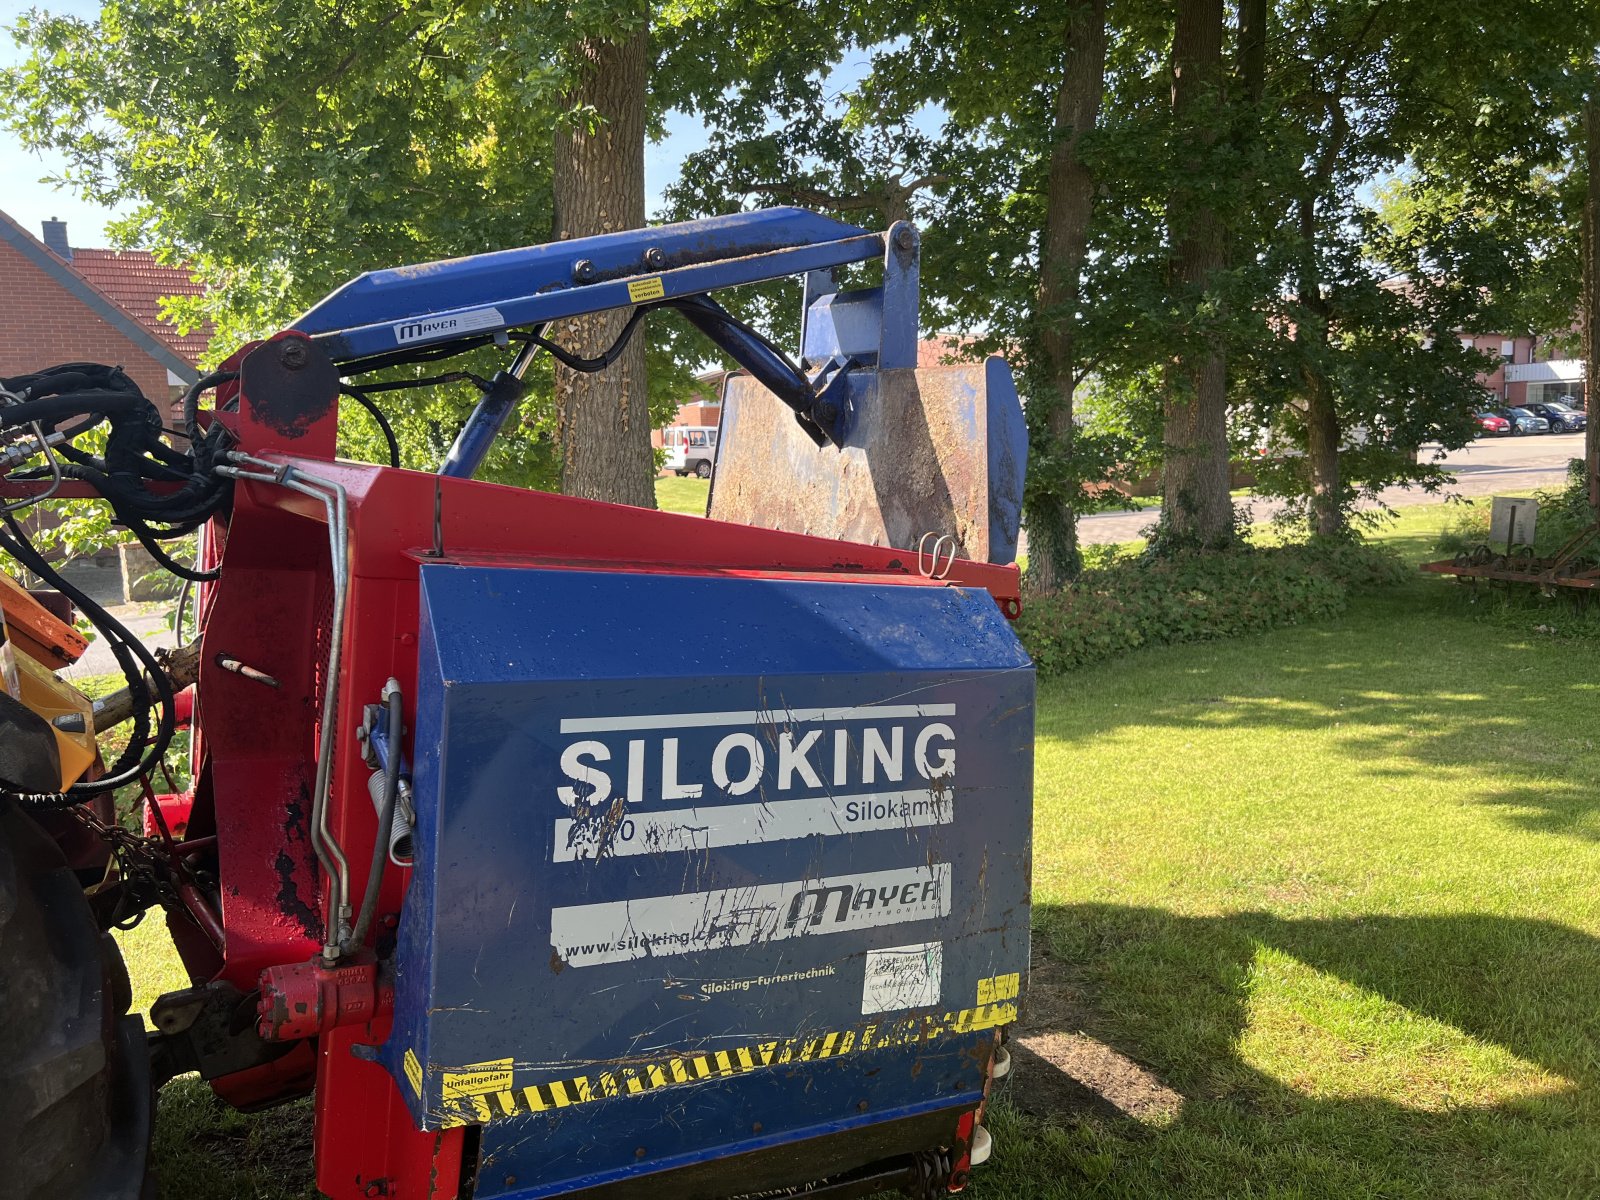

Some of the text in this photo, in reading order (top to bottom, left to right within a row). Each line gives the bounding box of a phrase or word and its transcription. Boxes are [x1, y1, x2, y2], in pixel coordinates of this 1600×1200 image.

[634, 290, 660, 299] verboten
[557, 723, 956, 807] SILOKING
[846, 799, 946, 821] Silokam
[446, 1073, 510, 1089] Unfallgefahr
